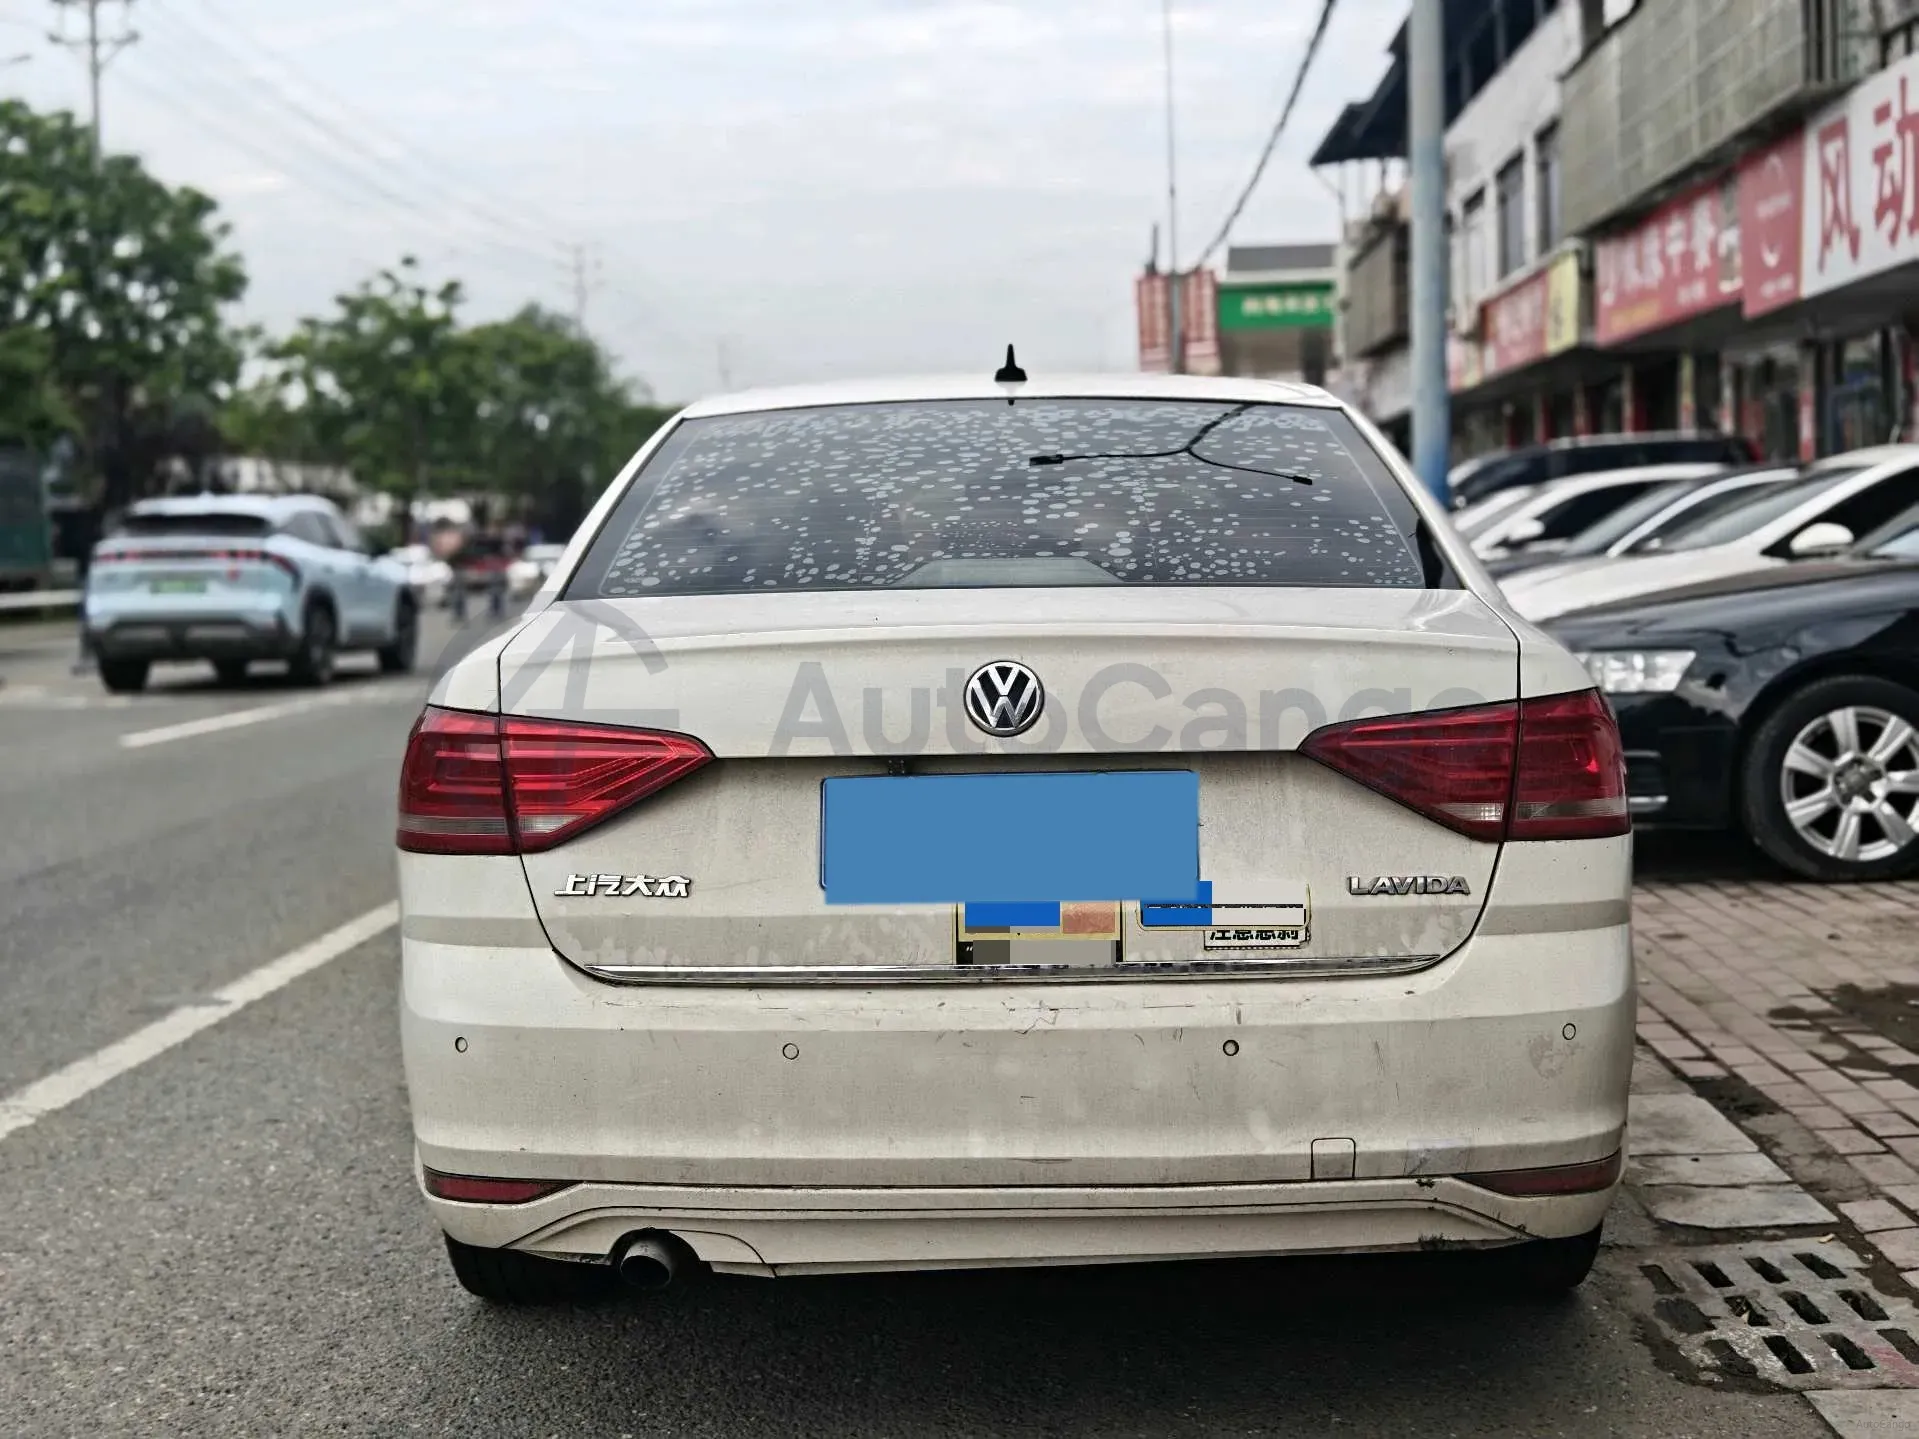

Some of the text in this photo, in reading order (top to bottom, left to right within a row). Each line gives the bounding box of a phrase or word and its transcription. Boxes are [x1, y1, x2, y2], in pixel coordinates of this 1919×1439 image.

[554, 873, 691, 897] 上汽大众
[1347, 876, 1470, 896] LAVIDA
